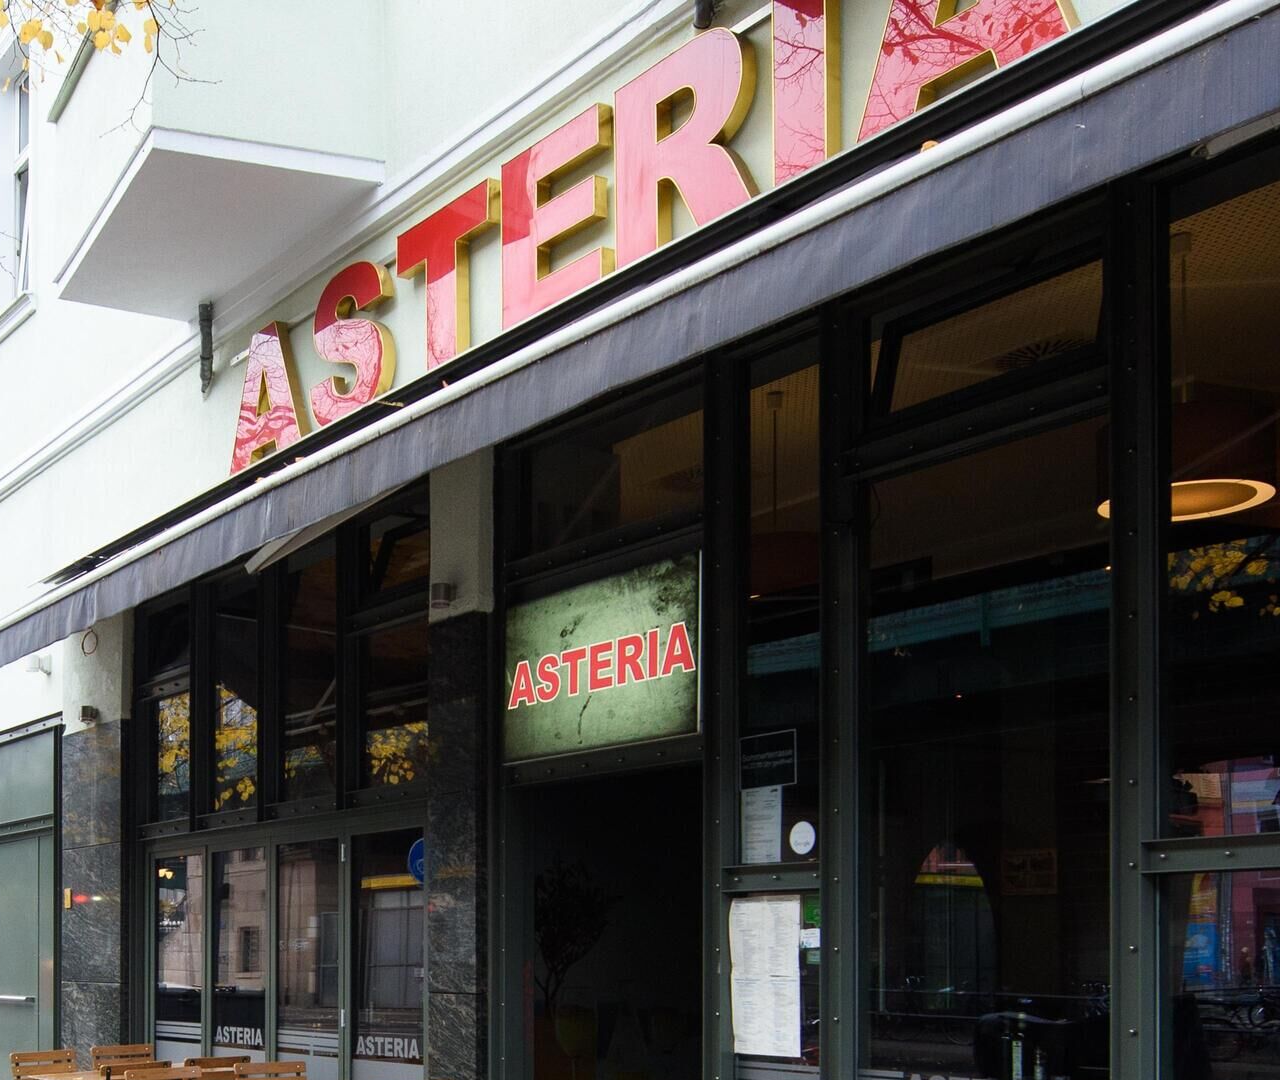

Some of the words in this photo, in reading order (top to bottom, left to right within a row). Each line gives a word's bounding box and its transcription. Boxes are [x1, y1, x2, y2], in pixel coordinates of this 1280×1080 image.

[229, 0, 1081, 477] ASTERIA
[508, 621, 696, 710] ASTERIA
[215, 1025, 263, 1046] ASTERIA
[356, 1035, 420, 1059] ASTERIA
